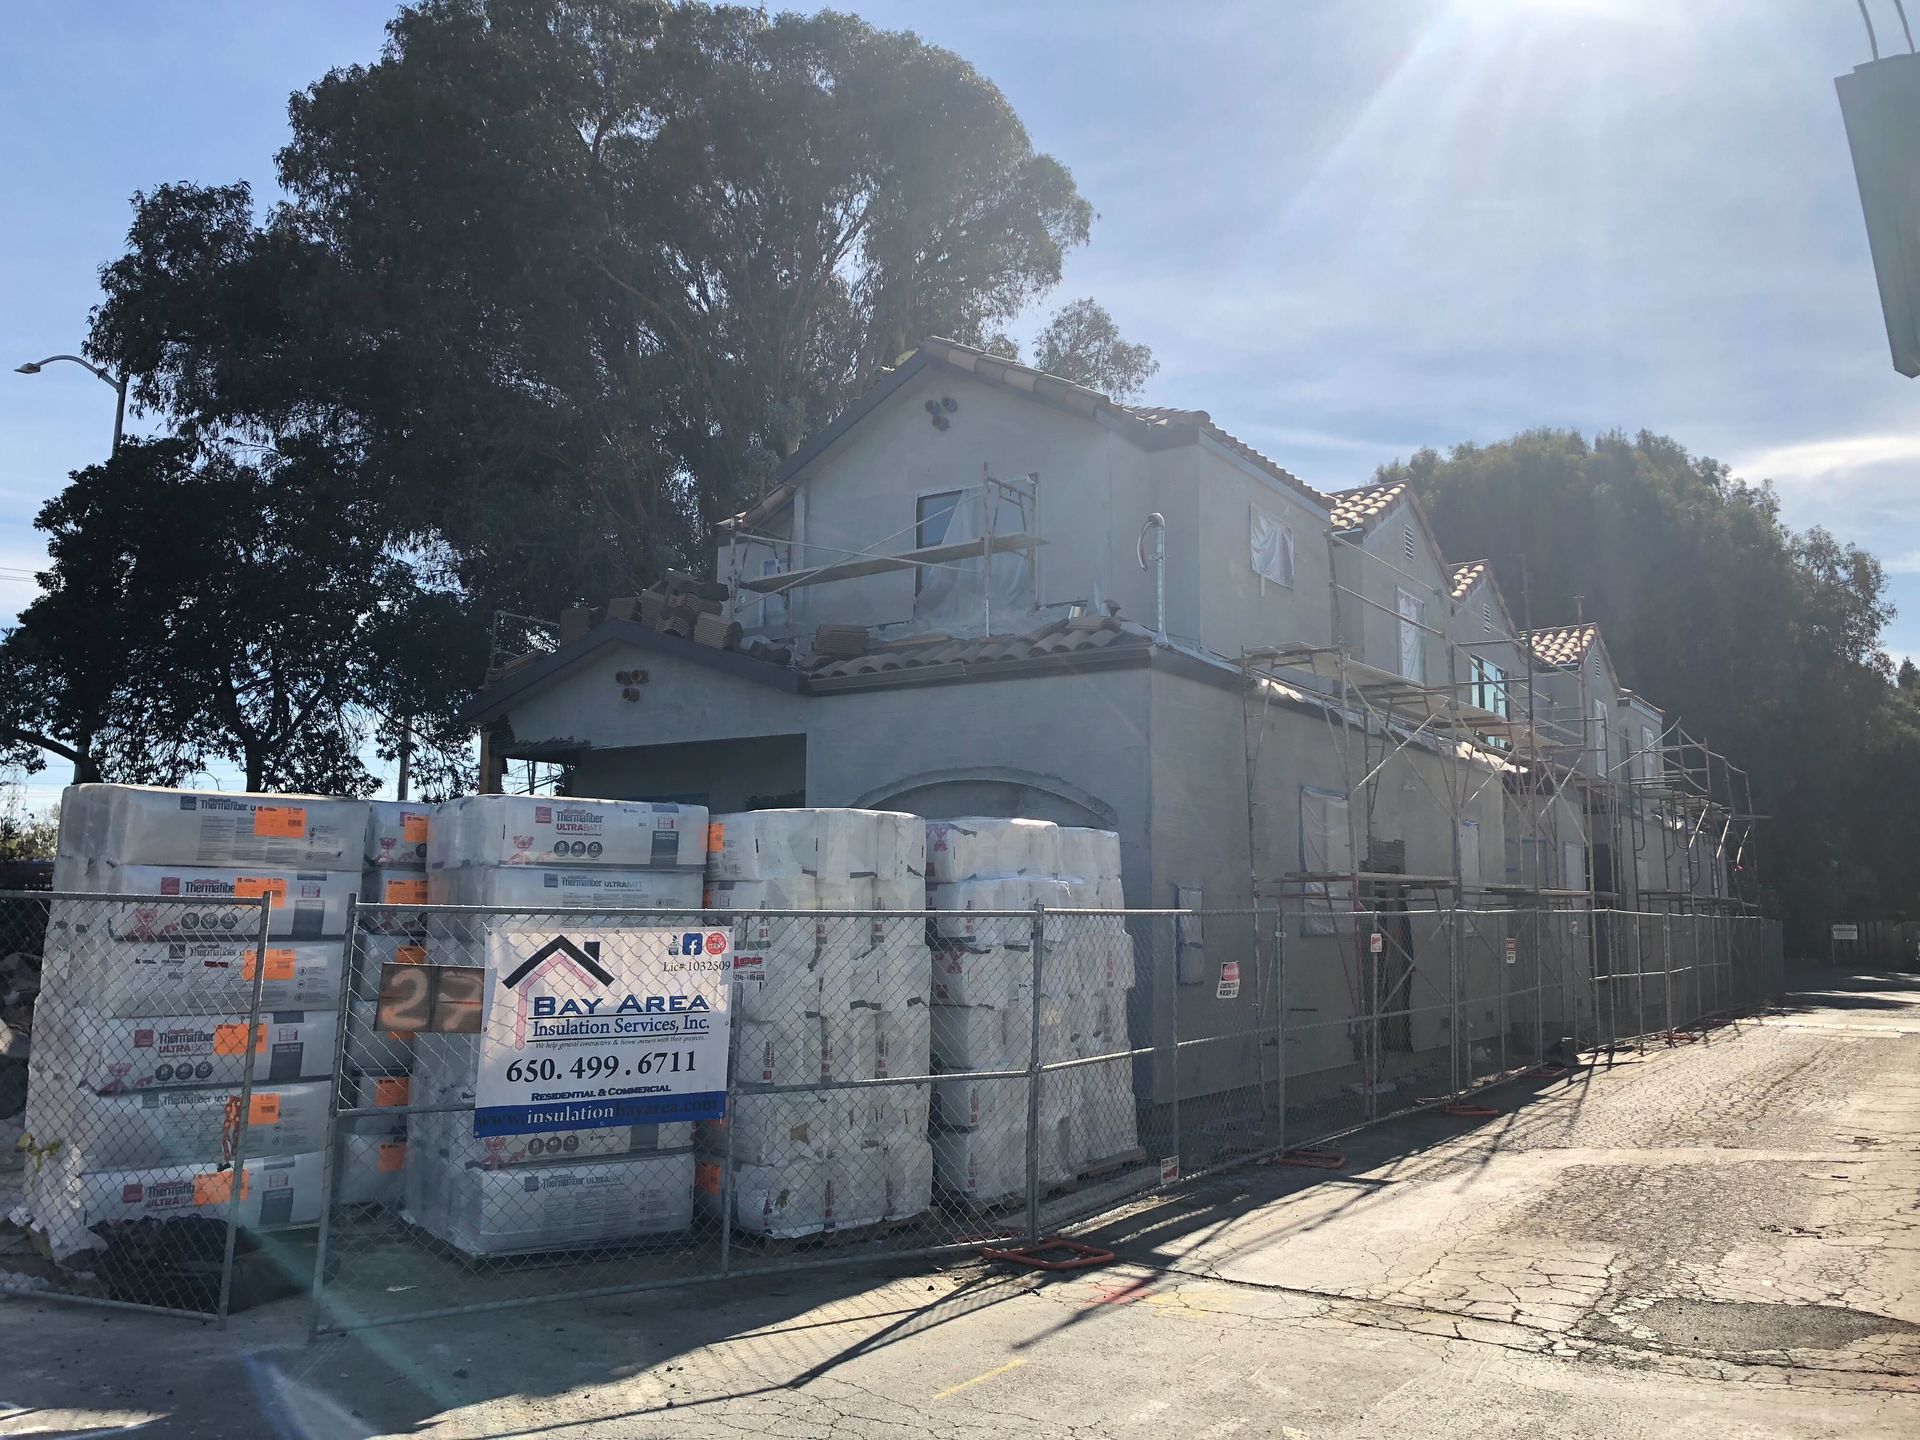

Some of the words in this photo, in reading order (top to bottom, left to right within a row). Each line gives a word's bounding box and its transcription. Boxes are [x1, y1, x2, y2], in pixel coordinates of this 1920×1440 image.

[556, 811, 604, 823] Thermafiber
[556, 823, 604, 831] ULTRABATT
[185, 881, 235, 893] Thermafibe
[688, 960, 731, 972] 1032509
[533, 995, 602, 1017] BAY
[616, 994, 710, 1014] AREA
[532, 1018, 610, 1037] Insulation
[614, 1017, 680, 1034] Services,
[683, 1014, 710, 1030] Inc.
[531, 1090, 597, 1102] RESIDENTIAL
[607, 1084, 672, 1097] COMMERCIAL
